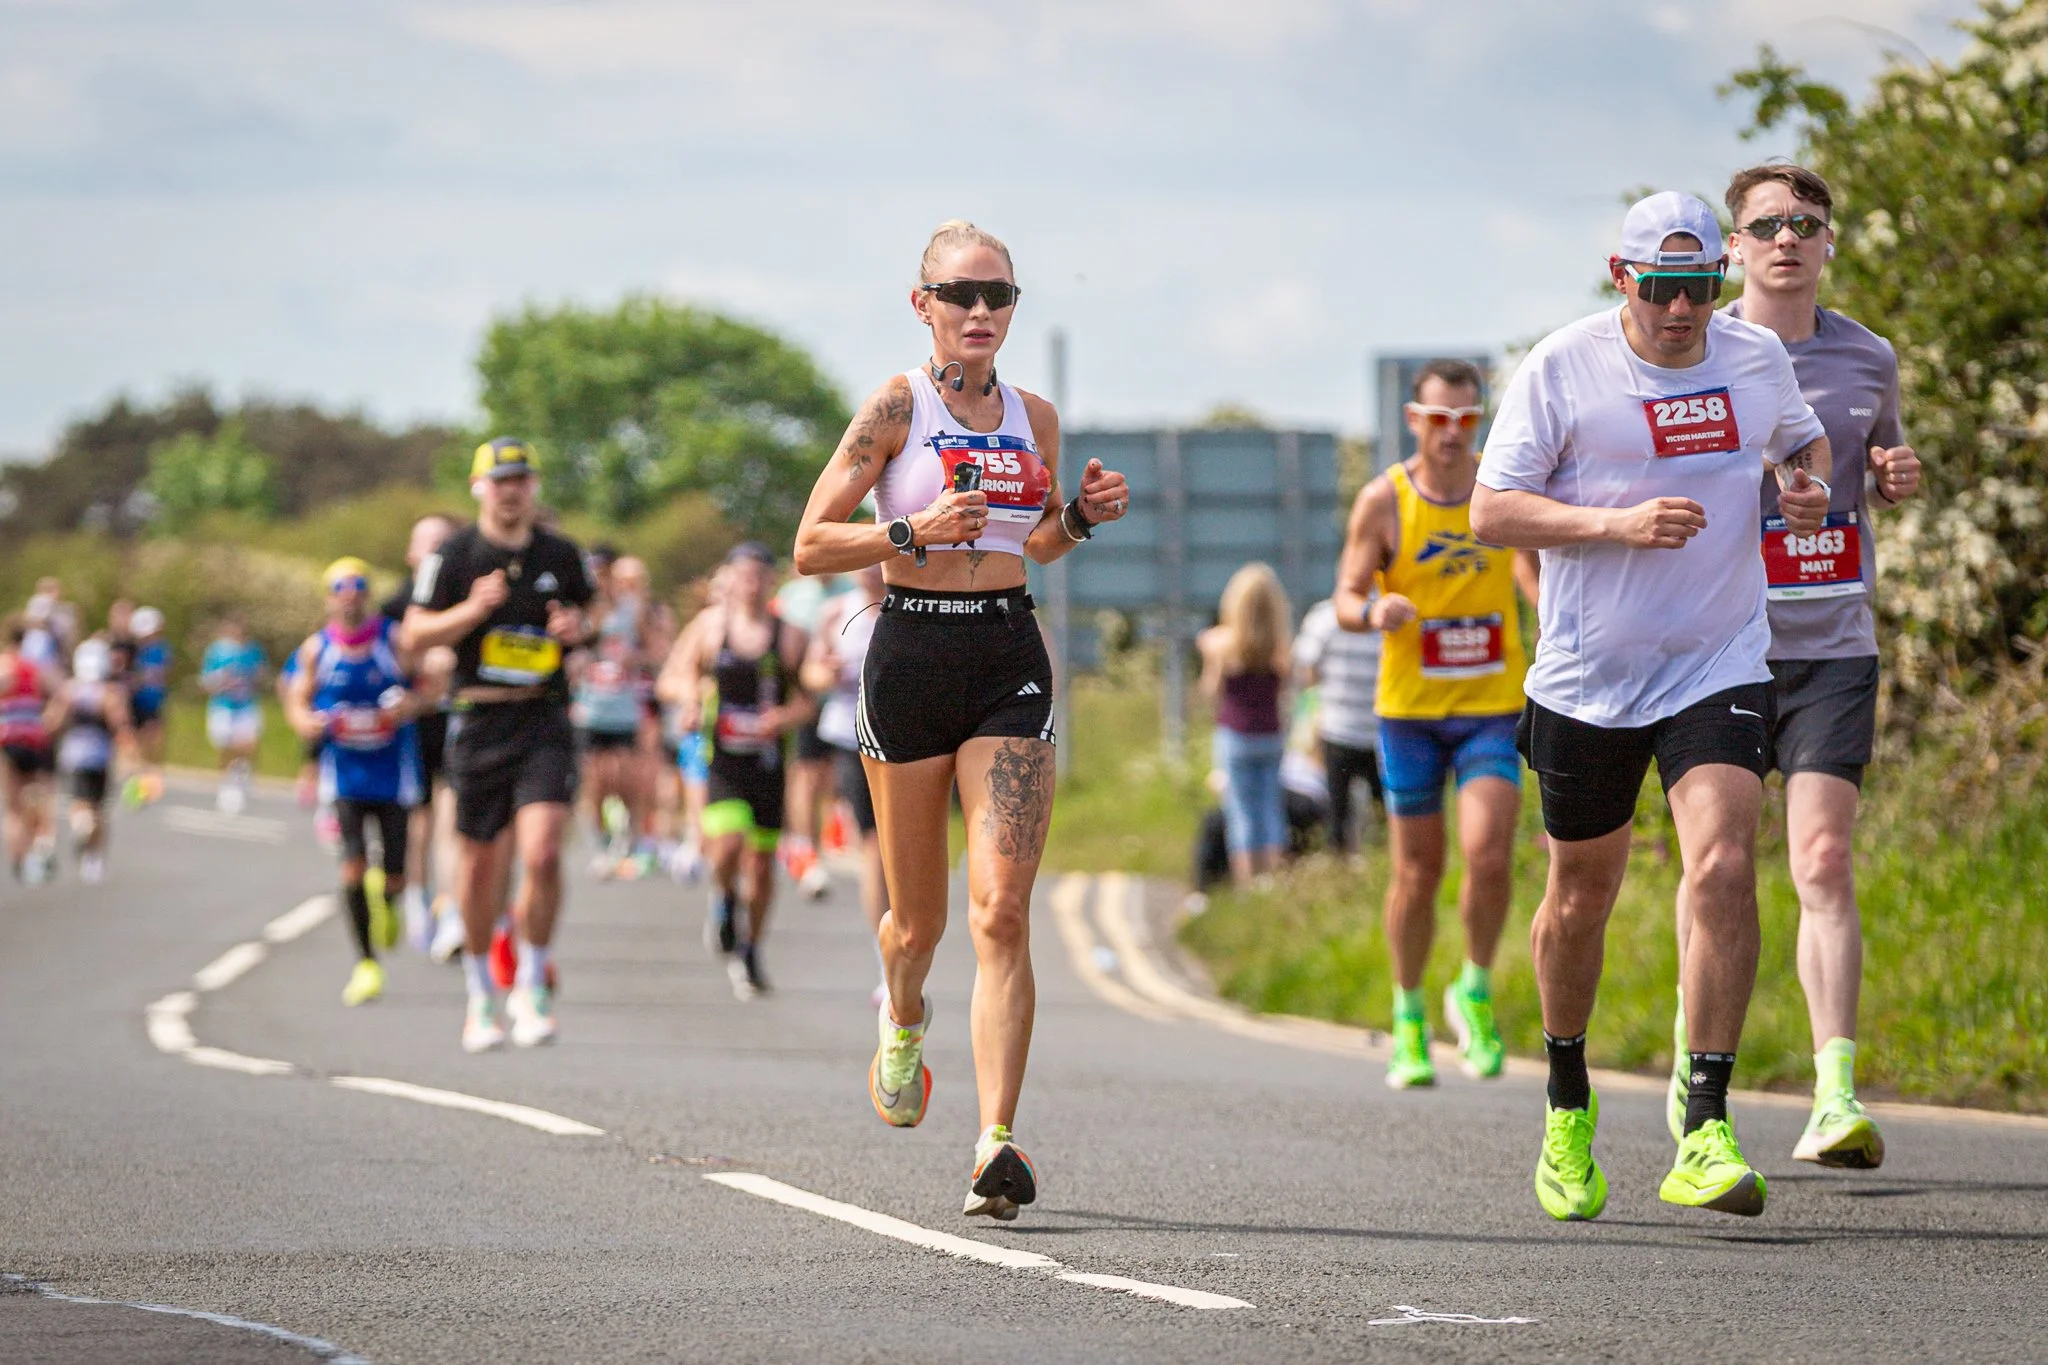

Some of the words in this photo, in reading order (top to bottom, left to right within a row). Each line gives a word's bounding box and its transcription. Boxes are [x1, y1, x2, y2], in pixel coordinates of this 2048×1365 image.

[1653, 397, 1727, 427] 2258
[1665, 433, 1691, 443] VICTOR
[968, 451, 1022, 475] 755
[1783, 529, 1846, 557] 1863
[1800, 559, 1835, 573] MATT
